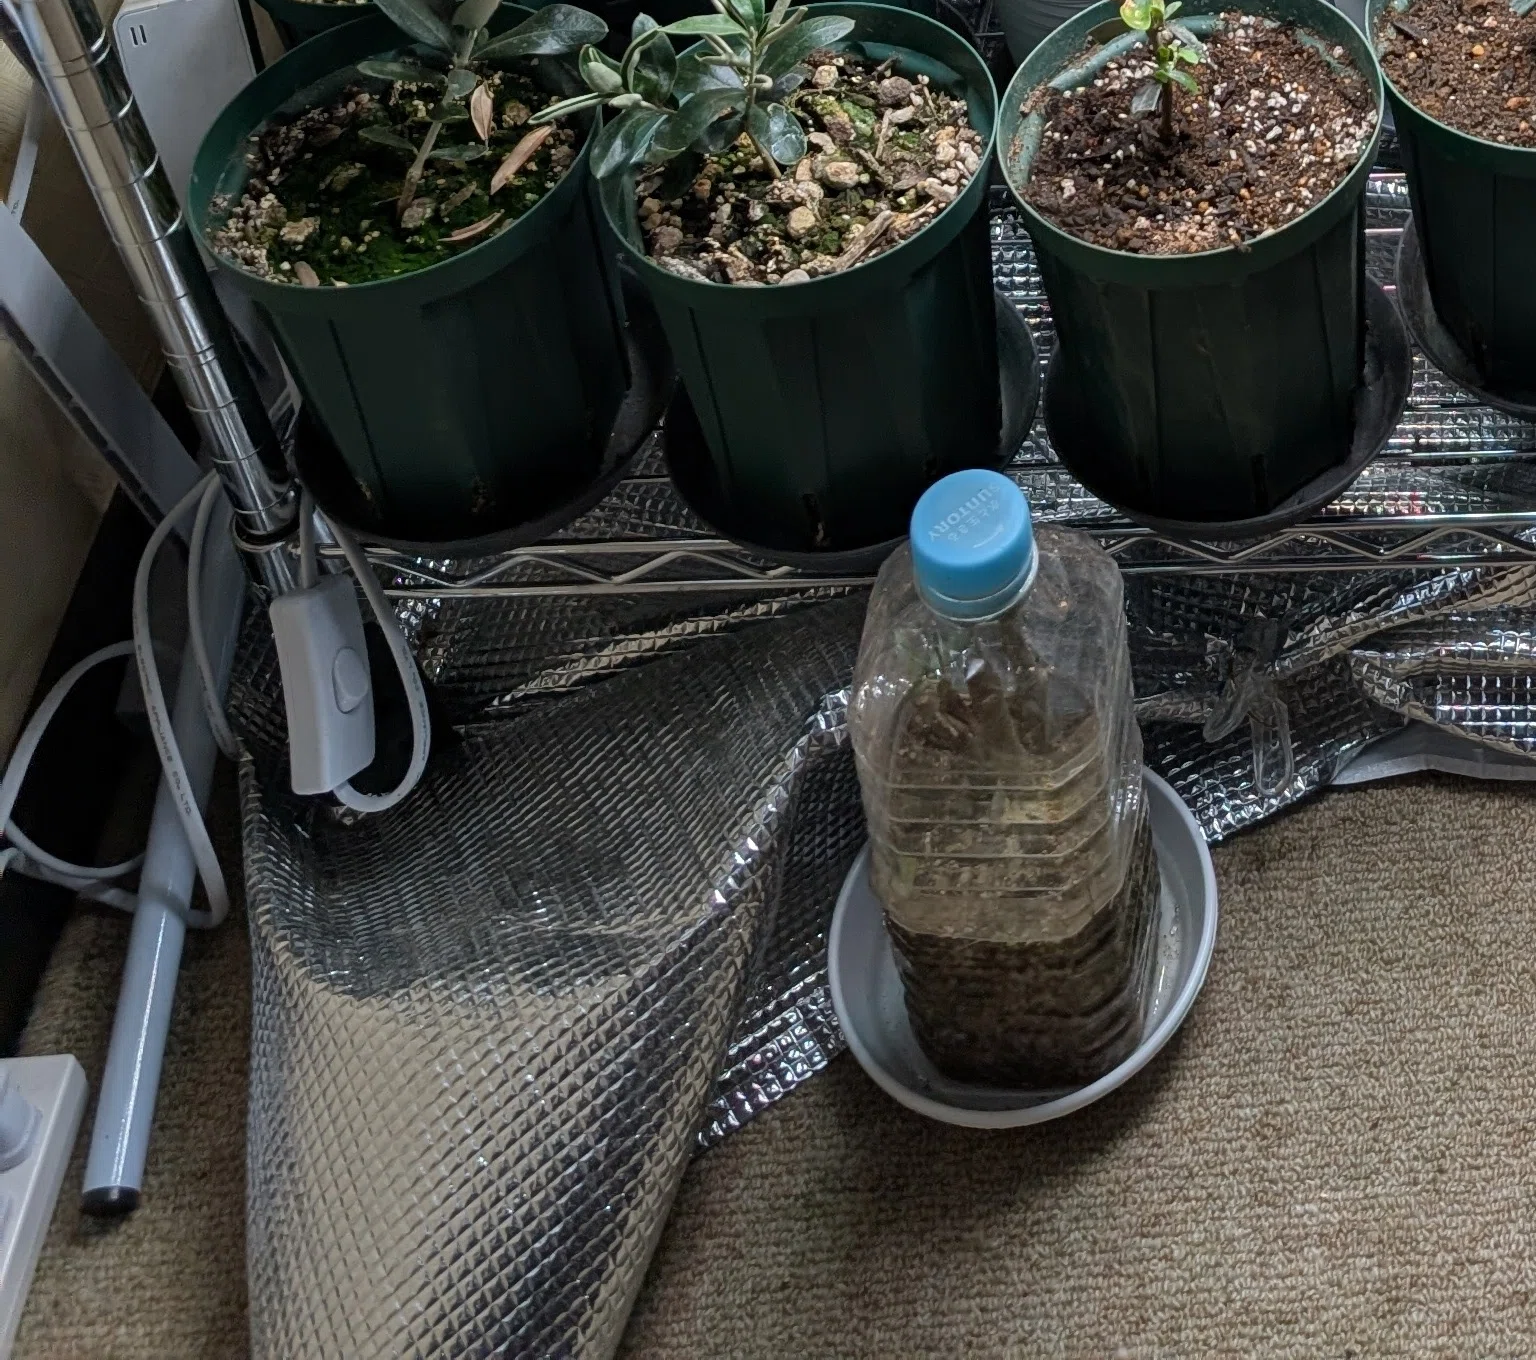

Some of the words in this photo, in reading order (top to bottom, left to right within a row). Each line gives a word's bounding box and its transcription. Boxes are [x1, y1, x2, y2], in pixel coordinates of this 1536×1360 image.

[928, 482, 1001, 543] SUNTORY
[947, 499, 1000, 542] 水と生きる
